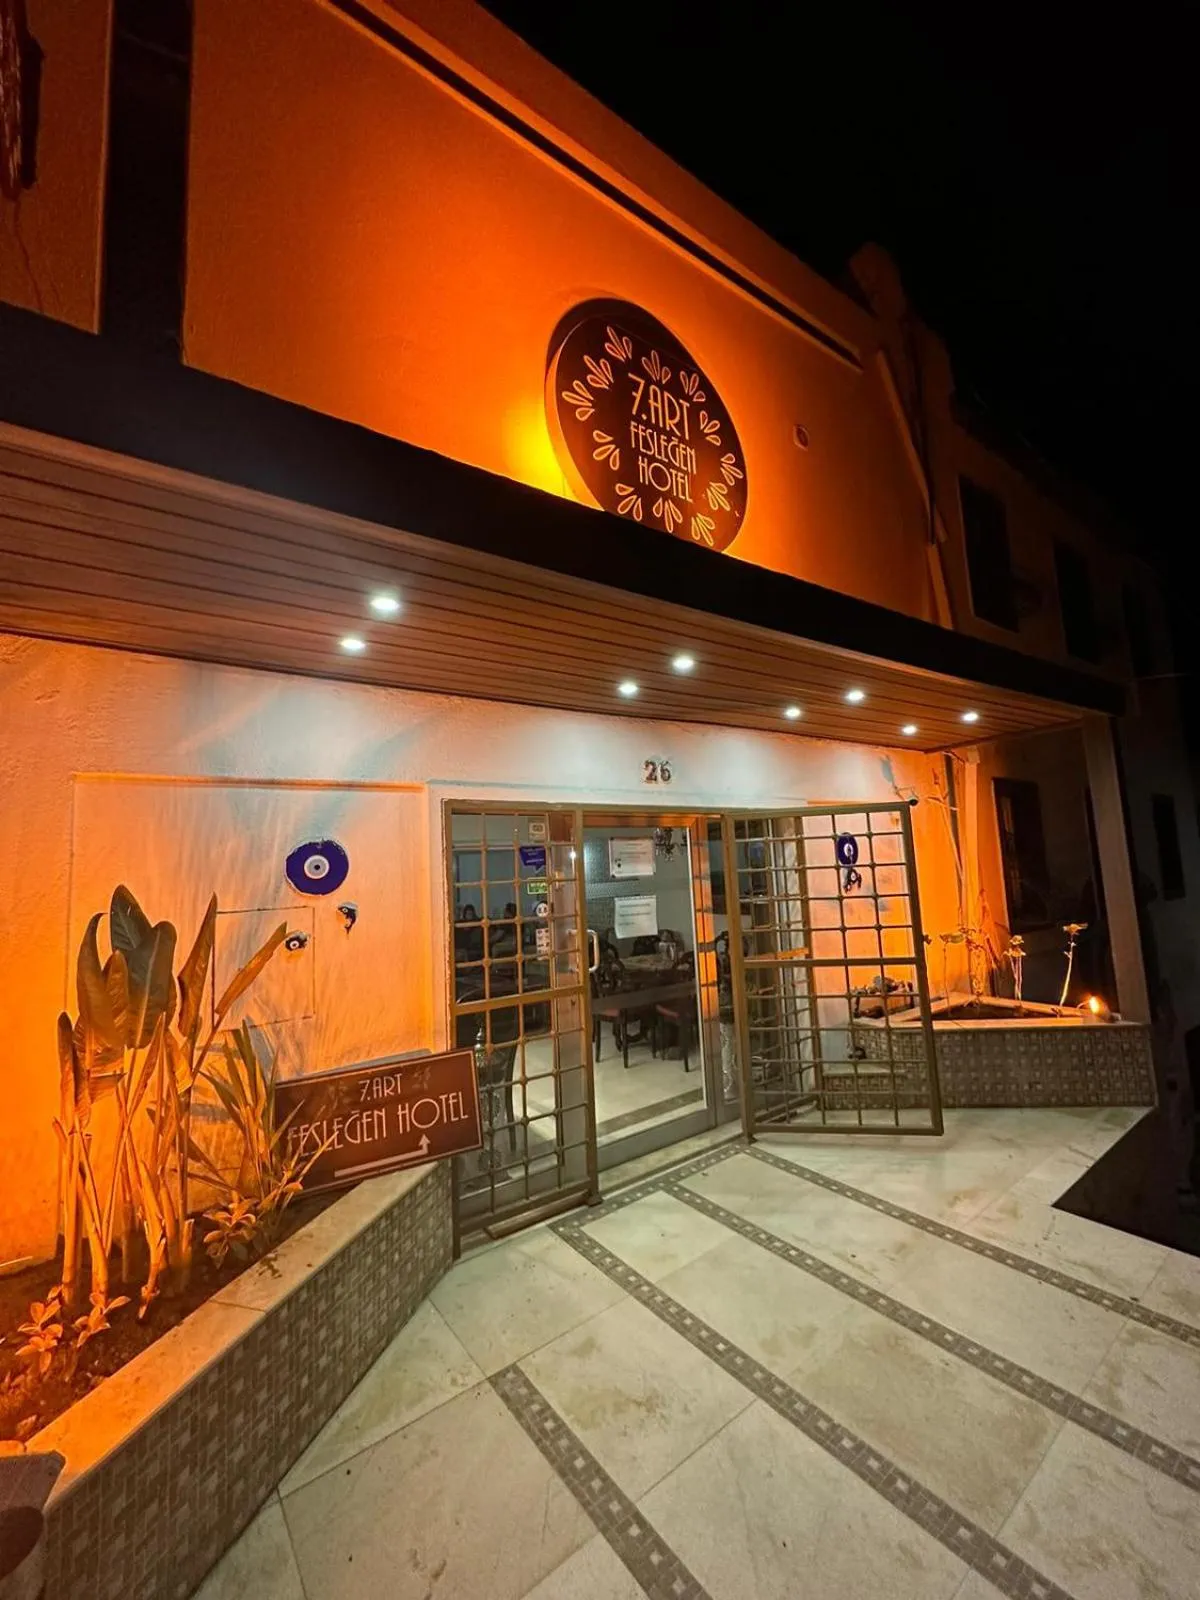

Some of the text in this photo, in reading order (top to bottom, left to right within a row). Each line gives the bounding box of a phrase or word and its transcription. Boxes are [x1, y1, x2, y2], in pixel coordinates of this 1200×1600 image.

[628, 372, 690, 440] 7.ART
[638, 456, 694, 504] HOTEL
[643, 758, 673, 785] 26
[358, 1073, 403, 1103] 7.ART
[397, 1091, 469, 1135] HOTEL
